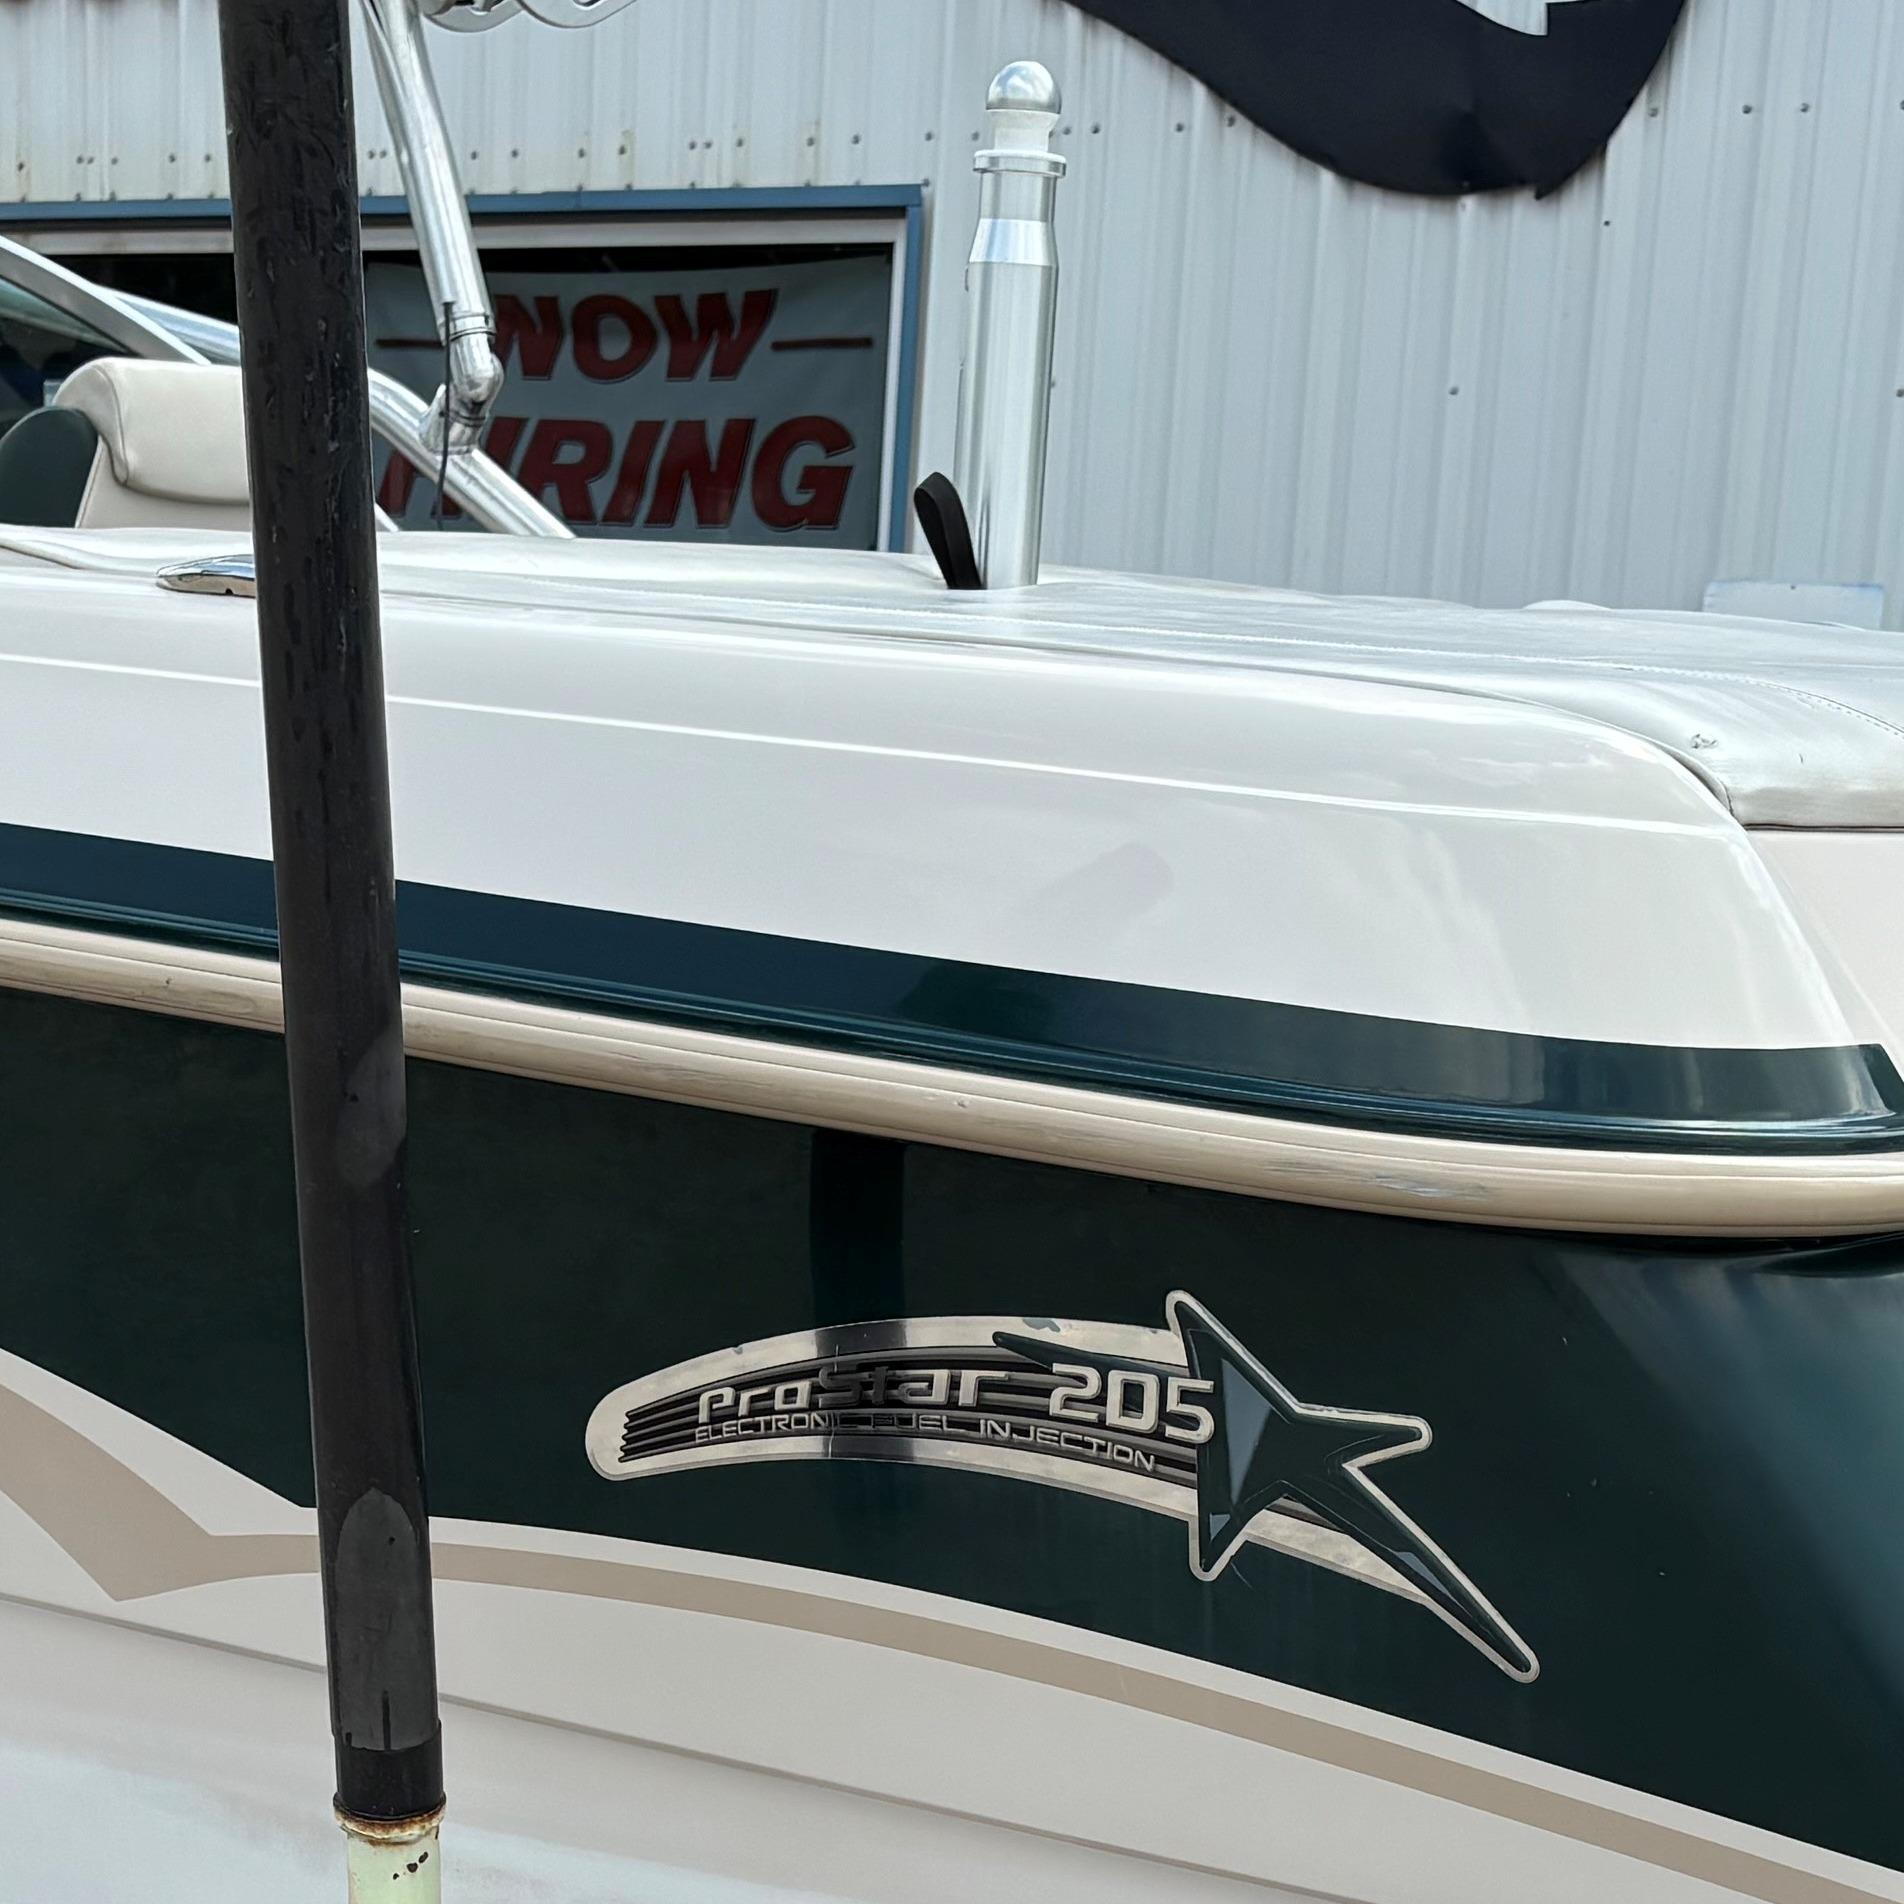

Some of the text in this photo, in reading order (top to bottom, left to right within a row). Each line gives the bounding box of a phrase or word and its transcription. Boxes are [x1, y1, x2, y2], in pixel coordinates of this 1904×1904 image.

[495, 288, 780, 383] NOW
[695, 1410, 1157, 1473] ELECTRONIC FUEL INJECTION
[698, 1362, 1215, 1445] ProStar 205
